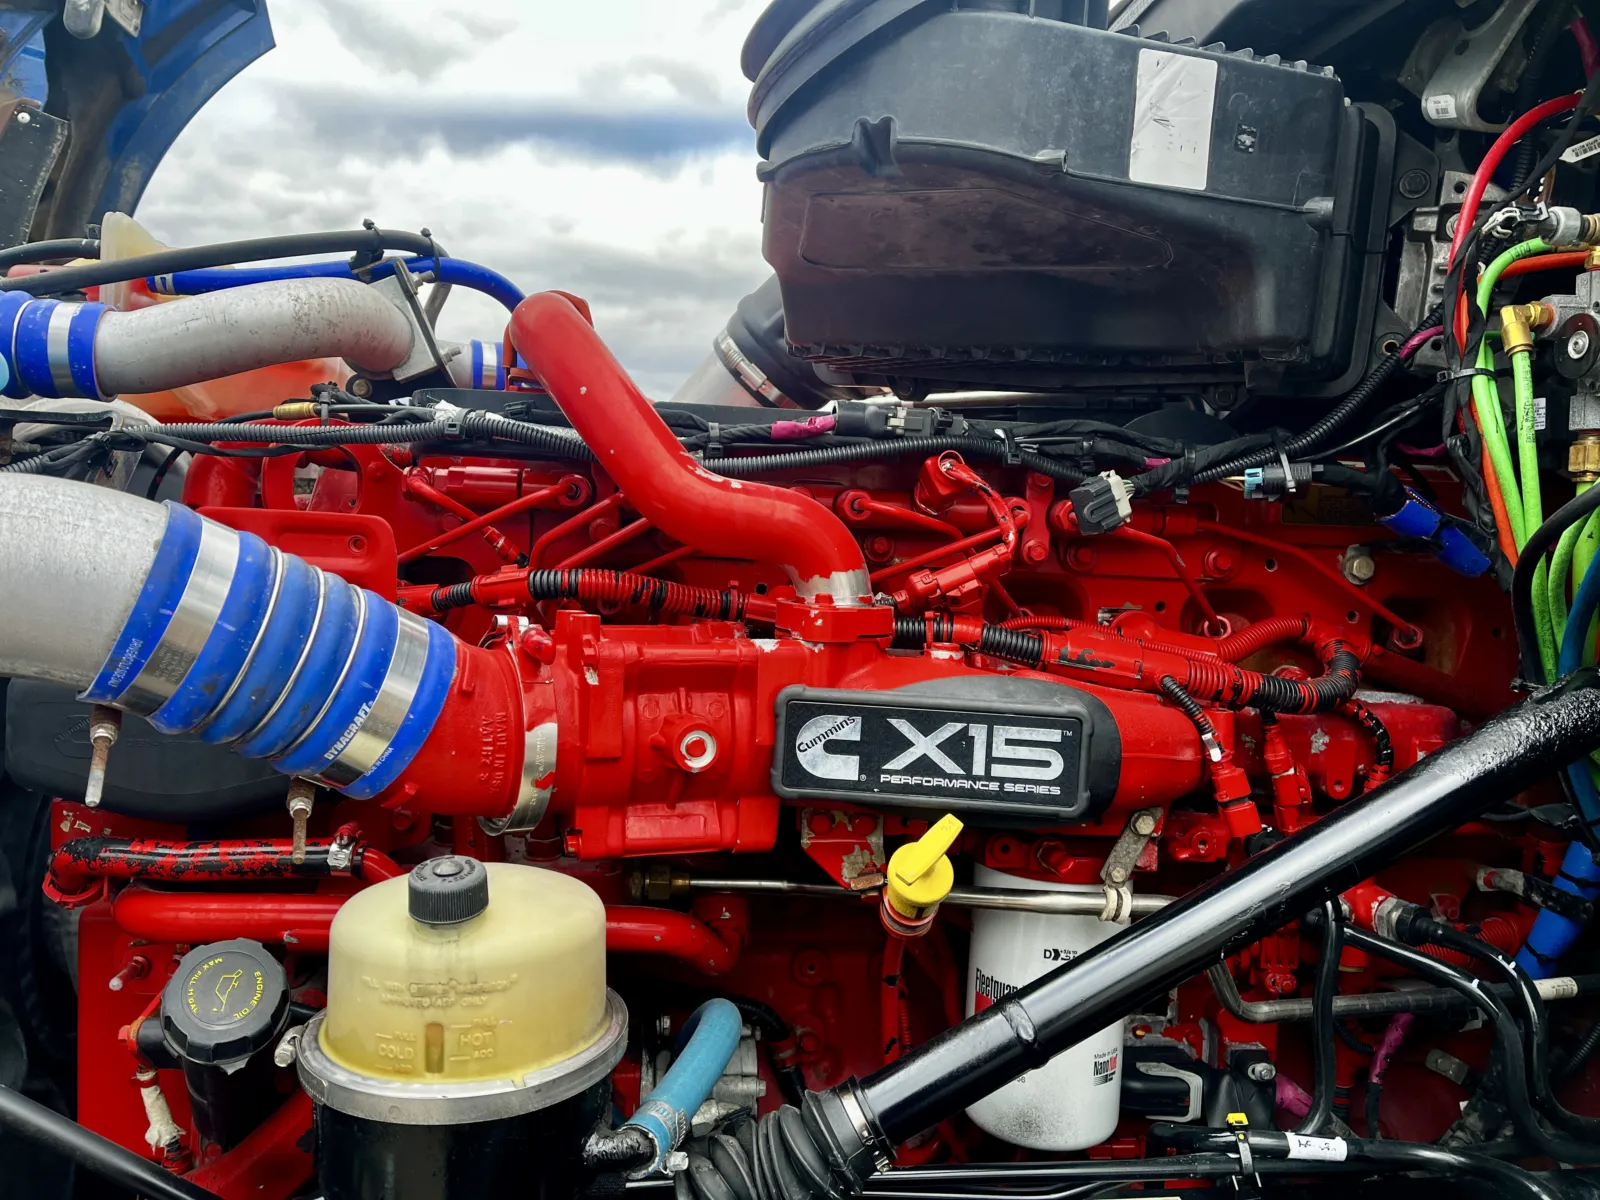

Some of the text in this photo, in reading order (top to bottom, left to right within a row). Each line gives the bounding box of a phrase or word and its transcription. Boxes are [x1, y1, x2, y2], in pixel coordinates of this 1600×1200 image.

[324, 702, 371, 760] DYNACRAFT
[797, 716, 856, 753] Cummins
[381, 747, 394, 762] CHINA
[881, 718, 1065, 781] X15
[880, 774, 1061, 796] PERFORMANCE SERIES
[203, 958, 223, 970] MAX
[189, 971, 203, 986] FILL
[233, 971, 264, 1020] ENGINE OIL
[188, 996, 199, 1014] GAL
[459, 1032, 493, 1046] HOT
[378, 1043, 415, 1060] COLD
